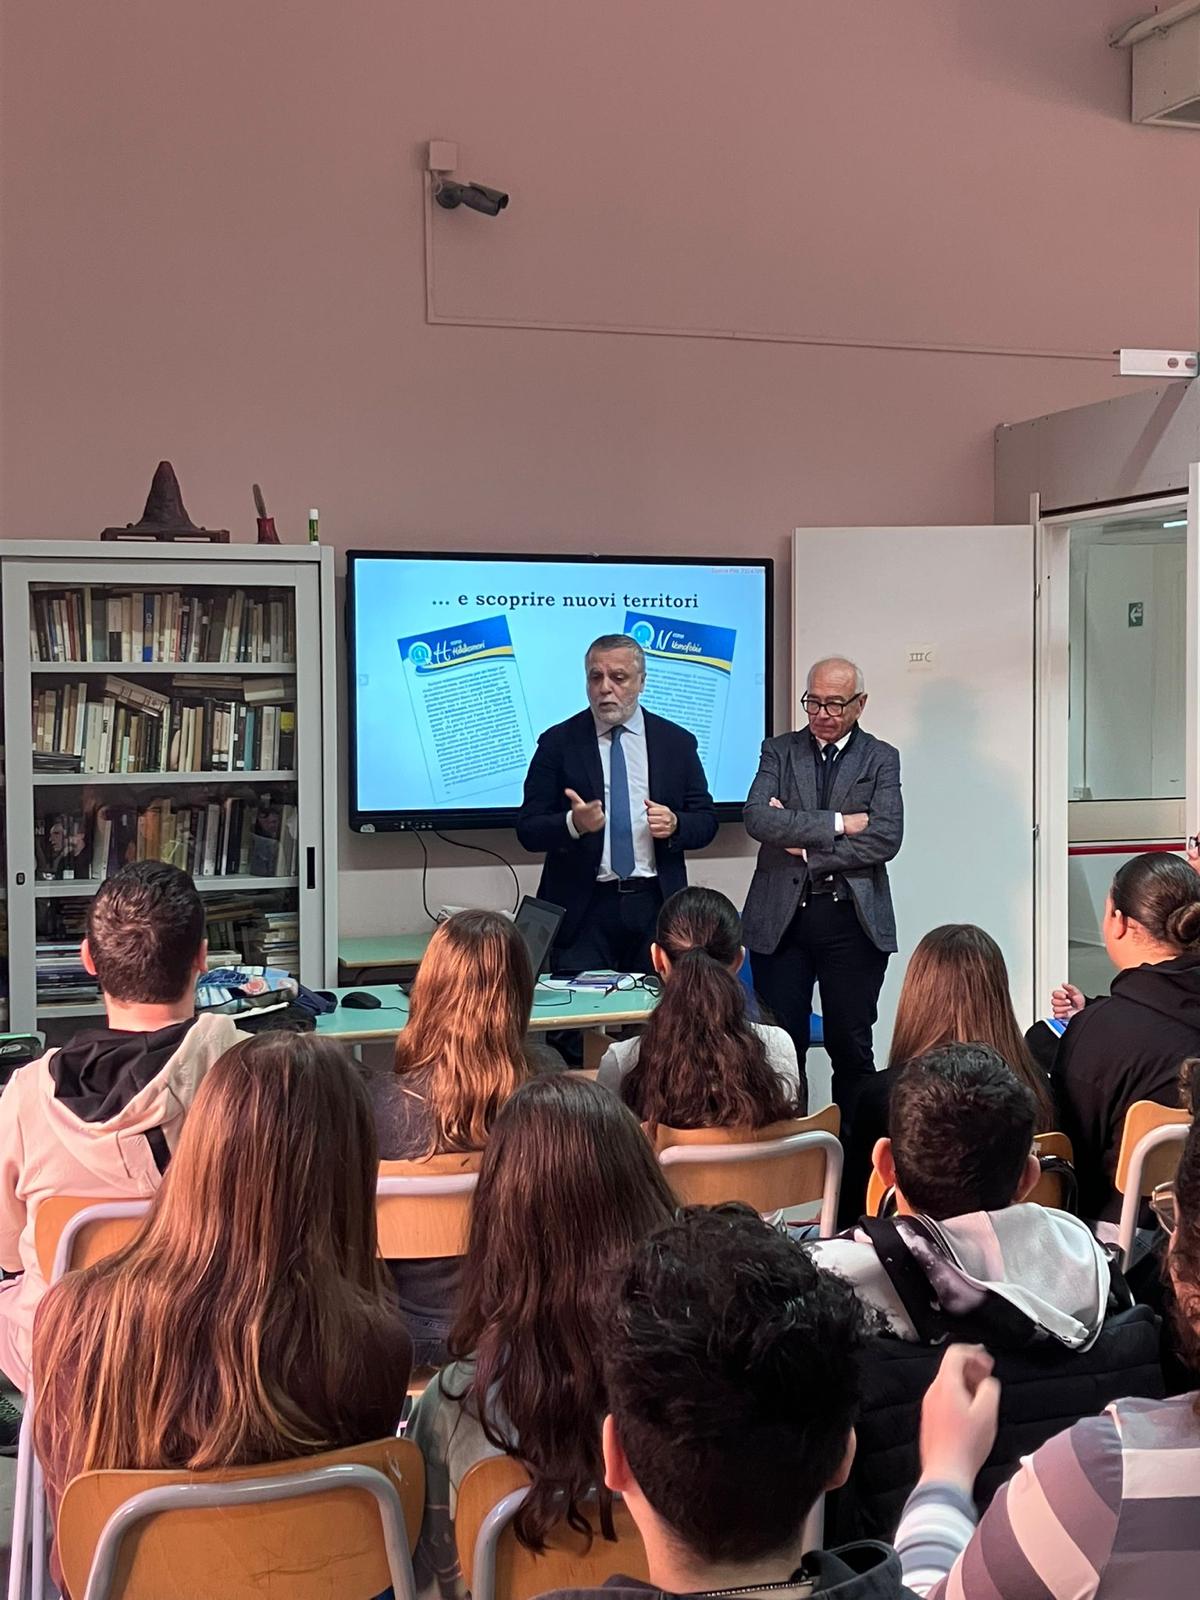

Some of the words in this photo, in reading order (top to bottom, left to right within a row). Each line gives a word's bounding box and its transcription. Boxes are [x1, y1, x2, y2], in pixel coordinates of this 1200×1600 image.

[458, 594, 469, 606] e
[476, 591, 556, 610] scoprire
[563, 593, 617, 608] nuovi
[623, 594, 699, 608] territori
[656, 630, 672, 651] N
